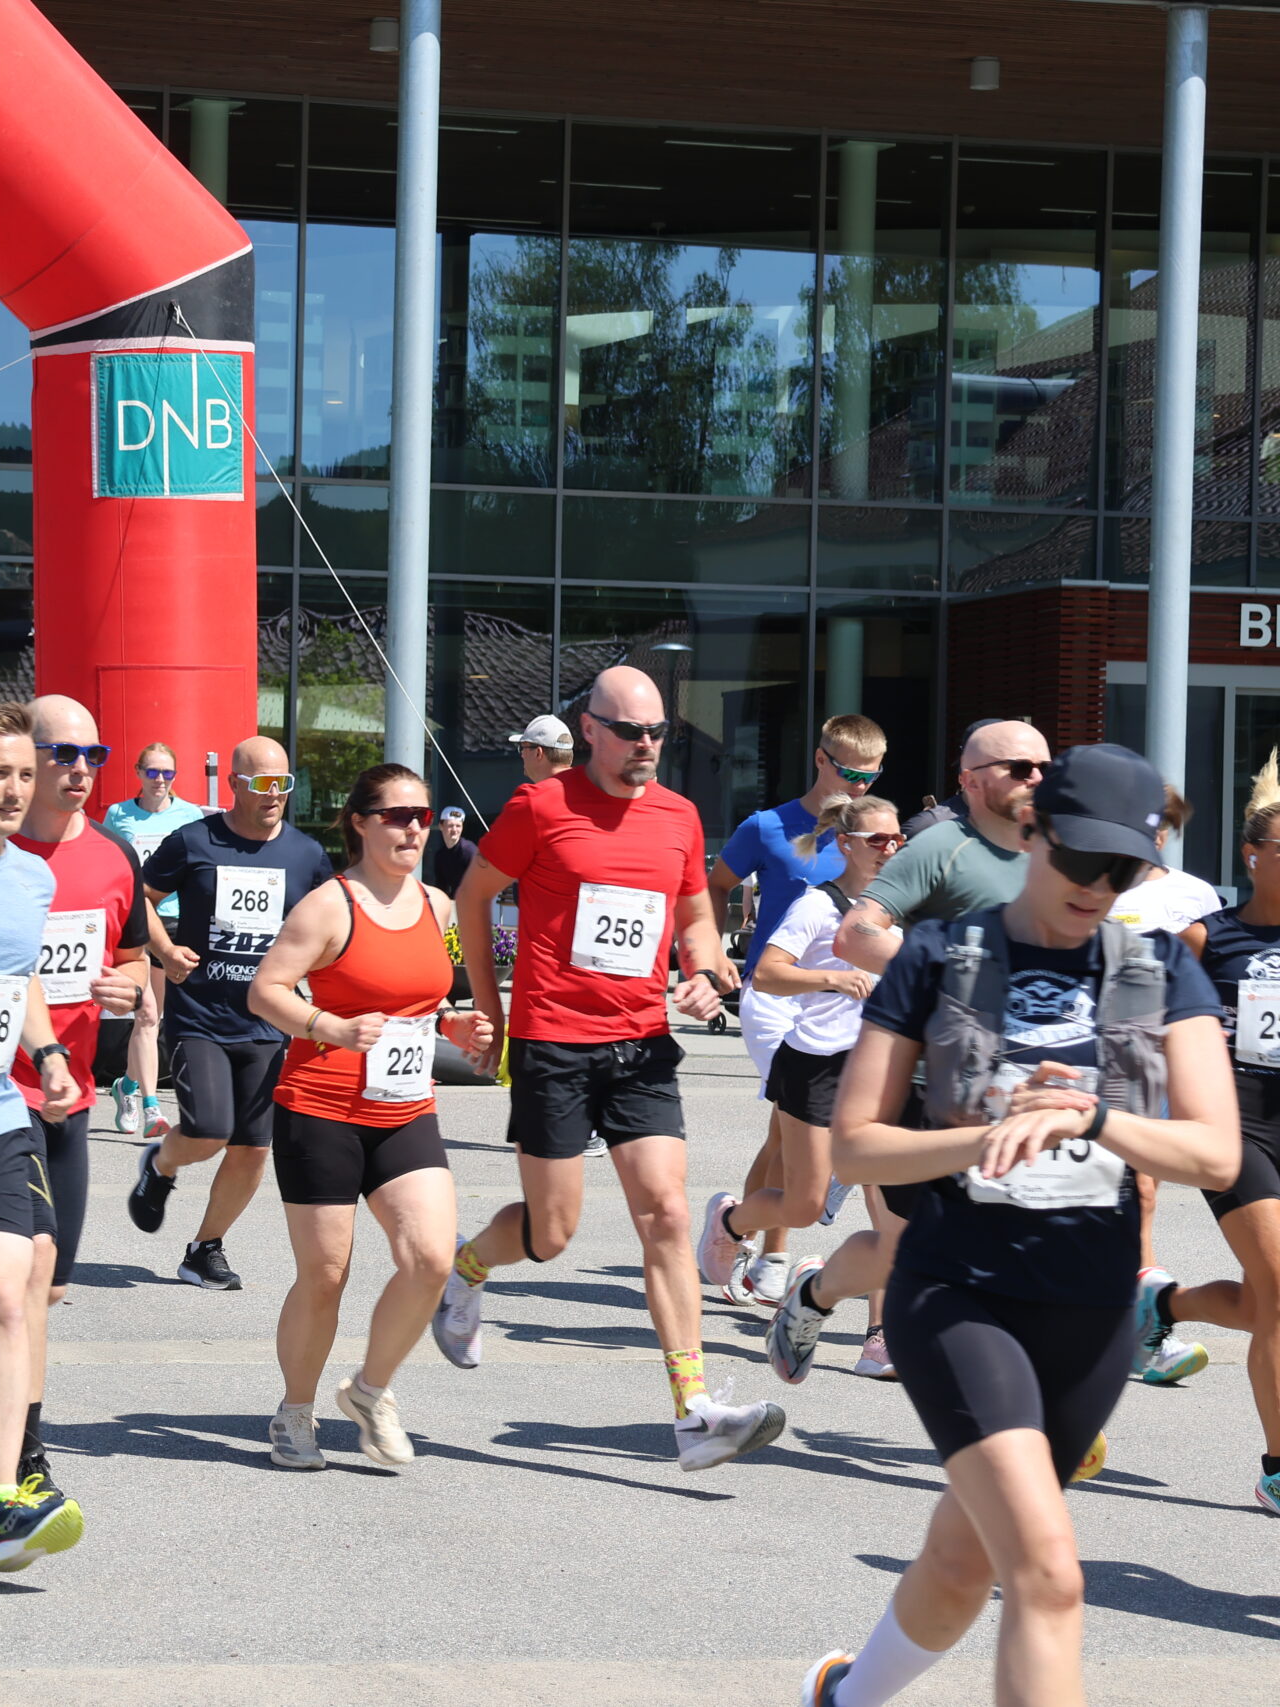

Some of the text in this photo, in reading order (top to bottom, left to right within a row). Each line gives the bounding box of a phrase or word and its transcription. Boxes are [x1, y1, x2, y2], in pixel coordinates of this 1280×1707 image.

[231, 889, 269, 912] 268
[594, 915, 644, 948] 258
[39, 942, 87, 974] 222
[1260, 1011, 1280, 1040] 2
[387, 1046, 424, 1076] 223
